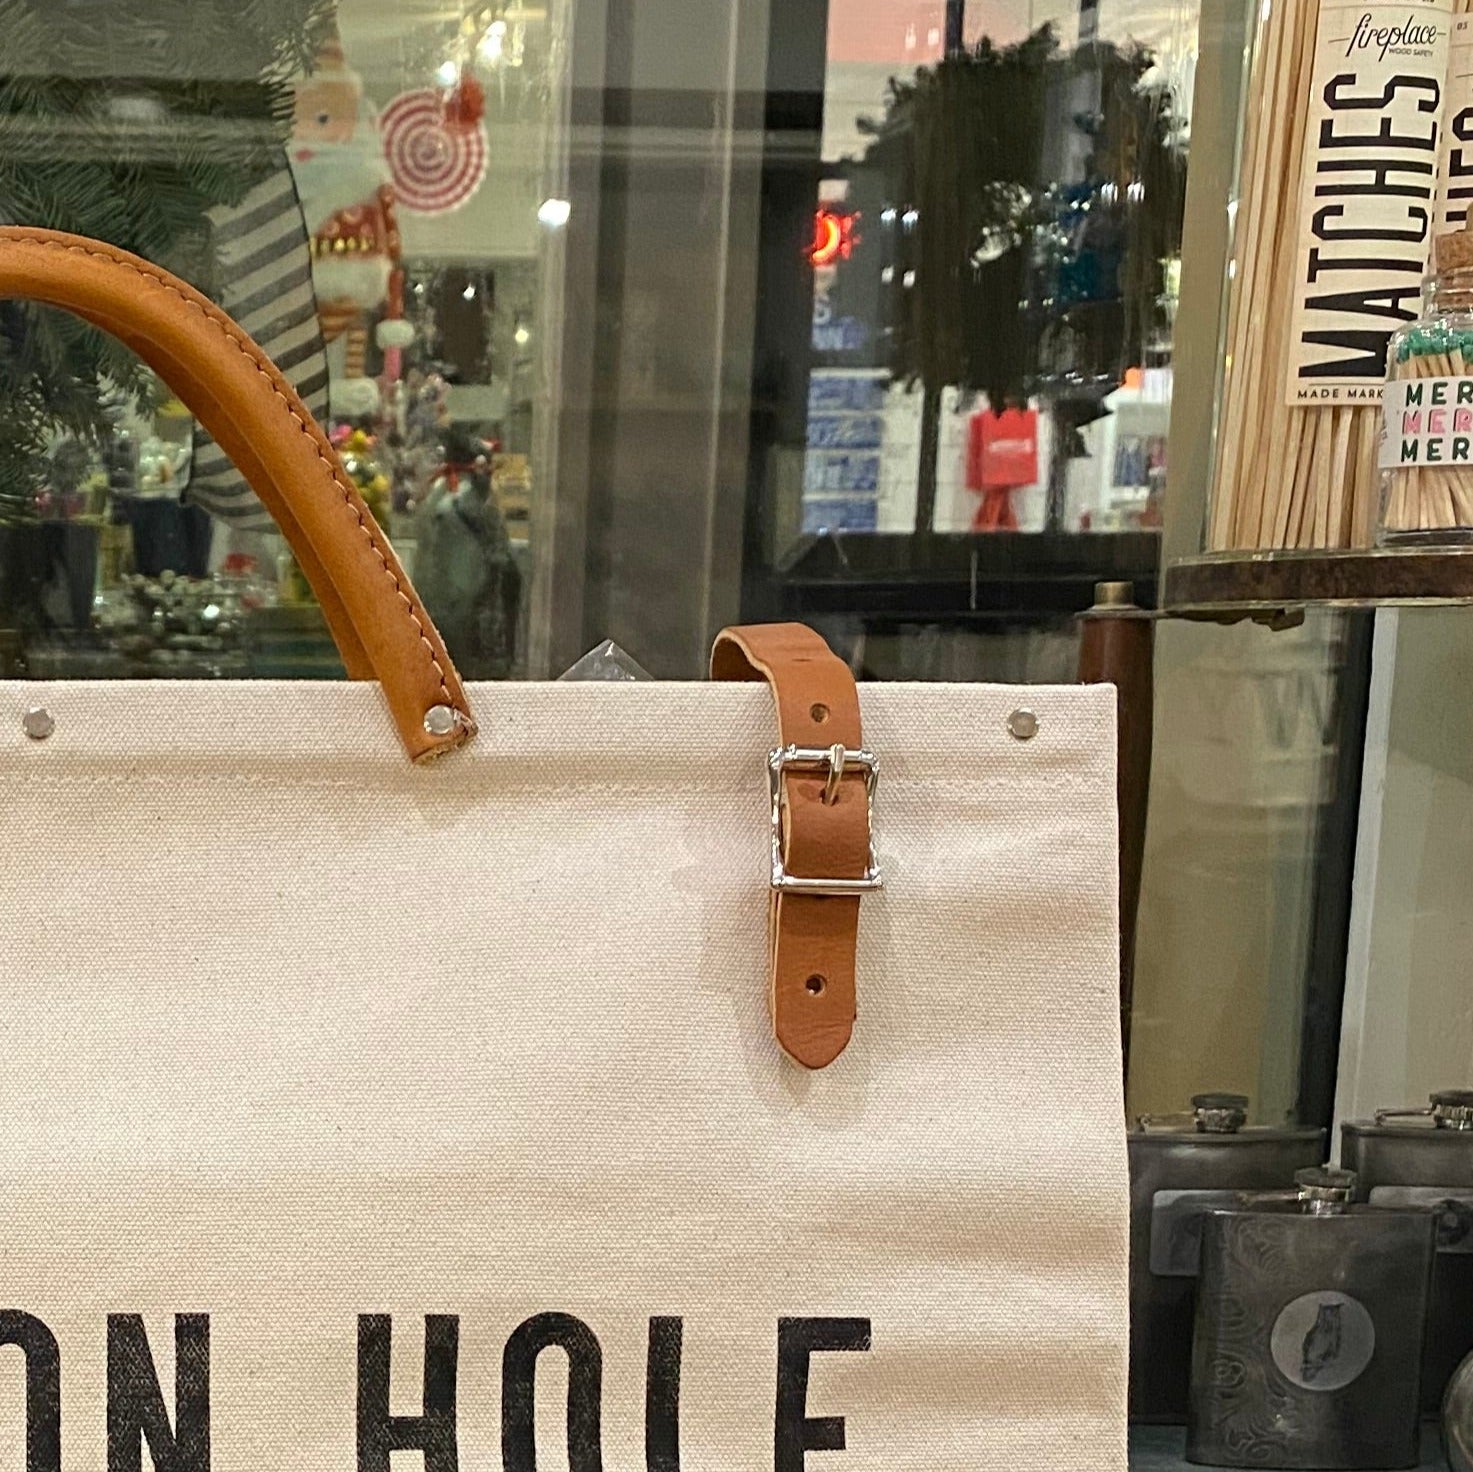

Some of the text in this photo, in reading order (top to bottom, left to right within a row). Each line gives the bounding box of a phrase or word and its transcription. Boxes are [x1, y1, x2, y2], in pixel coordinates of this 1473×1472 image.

[1345, 13, 1437, 62] fireplace
[1298, 73, 1440, 378] MATCHES
[1297, 388, 1340, 399] MADE
[1406, 381, 1473, 407] MER
[1400, 437, 1470, 463] MER
